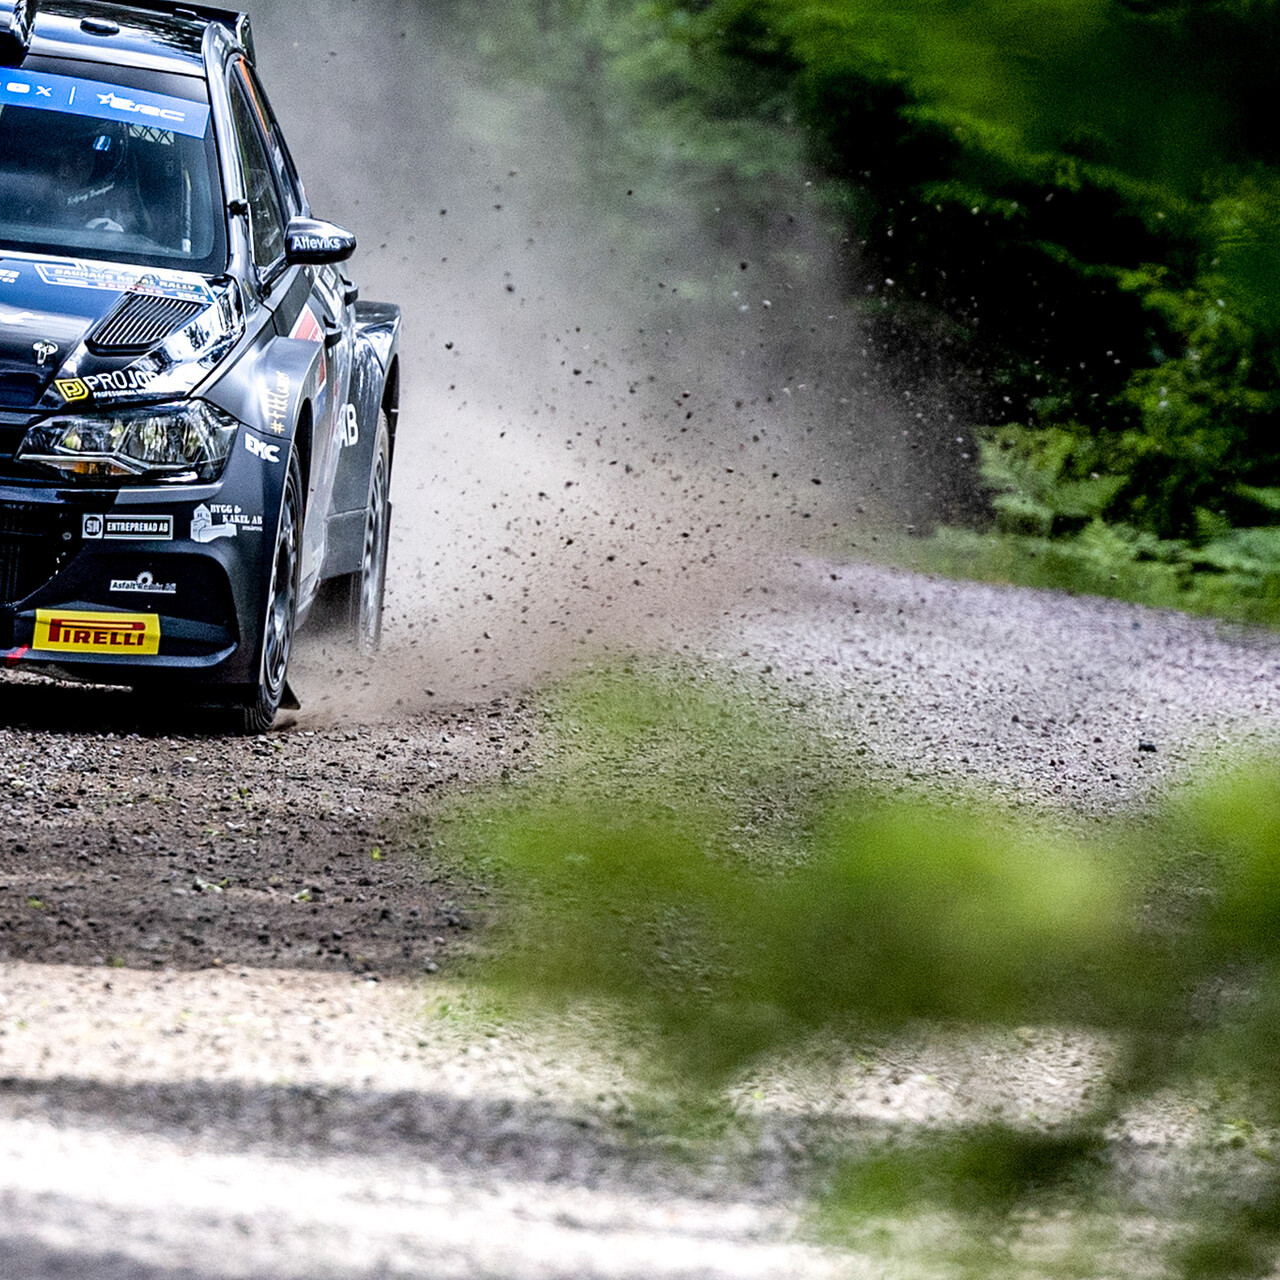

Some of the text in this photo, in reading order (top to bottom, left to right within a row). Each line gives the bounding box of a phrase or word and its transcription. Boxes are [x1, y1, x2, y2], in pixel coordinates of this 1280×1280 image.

[293, 236, 340, 250] Atteviks
[245, 433, 280, 463] EMC
[210, 504, 241, 514] BYGG &
[222, 514, 263, 525] KAKEL AB
[107, 522, 169, 532] ENTREPRENAD AB
[112, 581, 136, 590] Asfalt
[48, 618, 146, 646] PIRELLI
